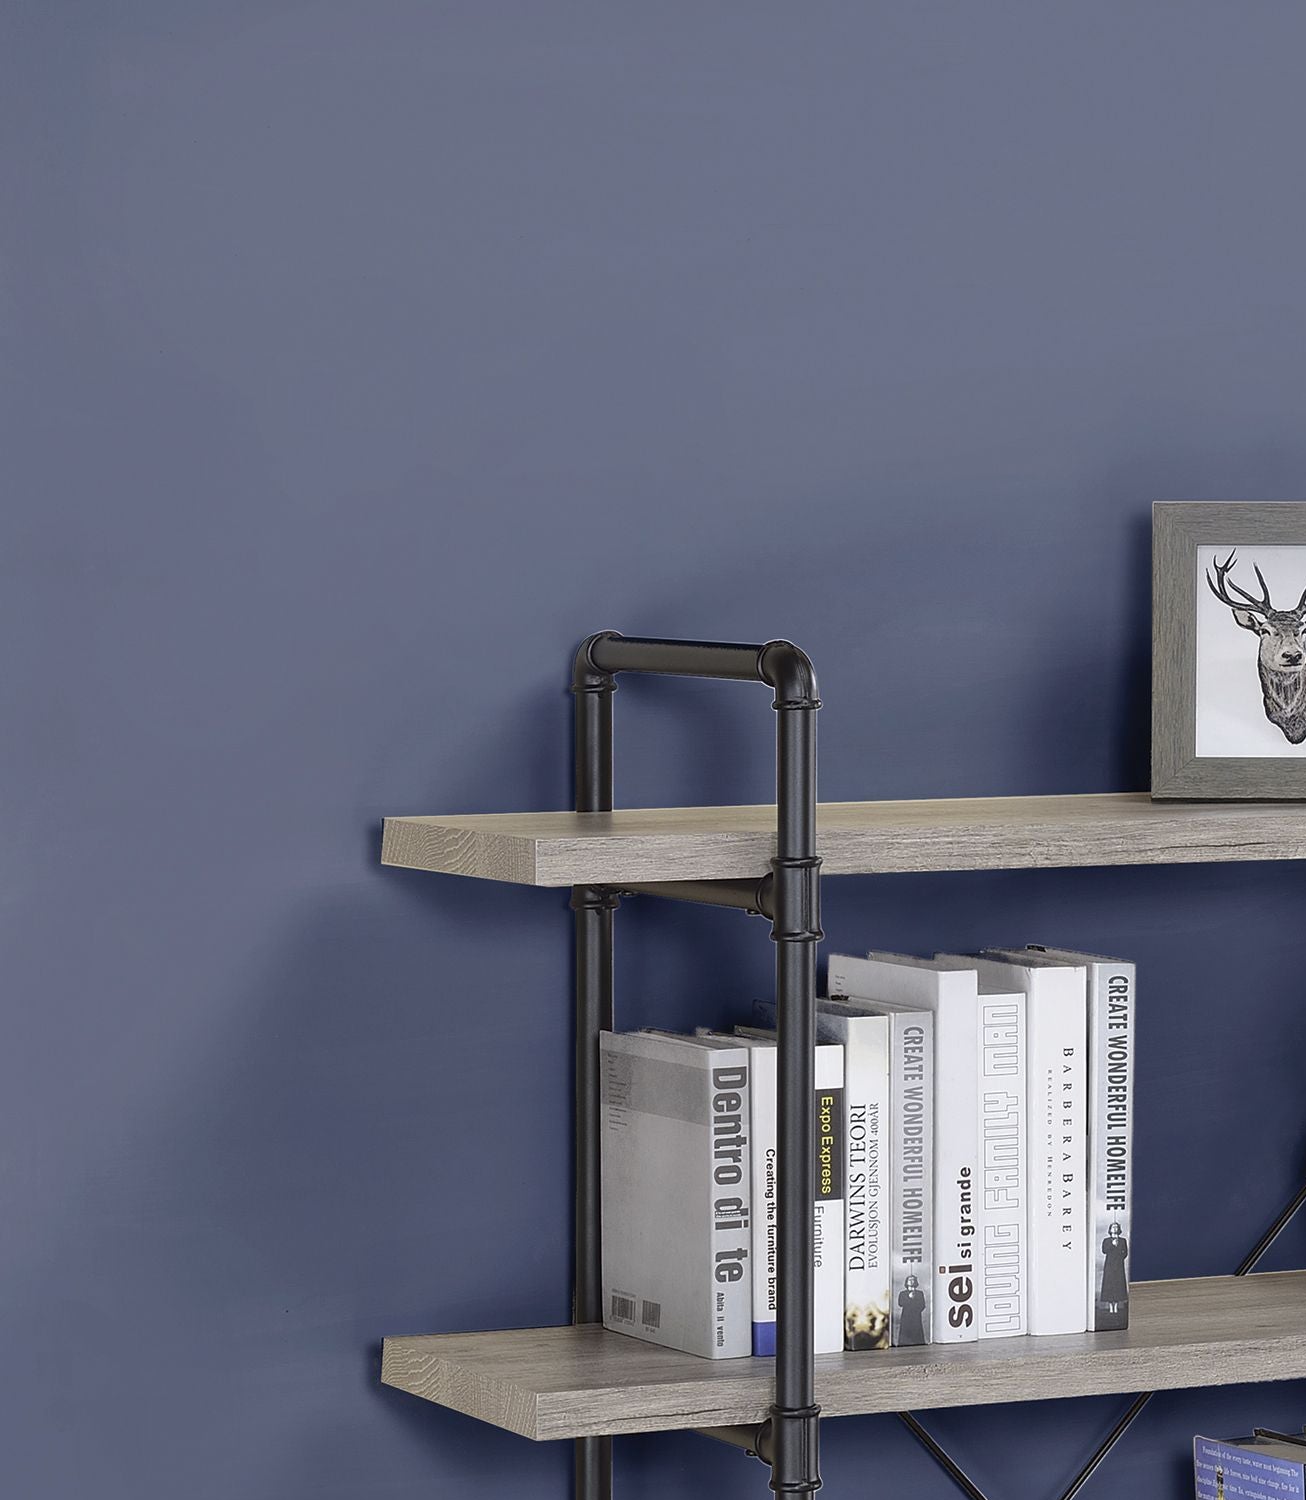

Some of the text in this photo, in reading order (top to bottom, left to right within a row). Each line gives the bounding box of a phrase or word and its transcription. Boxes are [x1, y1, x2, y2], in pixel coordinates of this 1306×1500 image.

[712, 1066, 747, 1185] Dentro
[1106, 975, 1129, 1211] CREATE WONDERFUL HOMELIFE
[819, 1096, 833, 1194] Expo Express
[849, 1104, 867, 1271] DARWINS TEORI
[868, 1138, 881, 1197] GJENNOM
[902, 1026, 925, 1263] CREATE WONDERFUL HOMELIFE
[983, 1004, 1020, 1332] LOVING FAMILY MAN
[714, 1197, 749, 1231] di
[765, 1148, 777, 1311] Creating the furniture brand
[814, 1206, 825, 1268] Furniture
[868, 1200, 881, 1269] EVOLUSJON
[938, 1166, 975, 1328] sei si grande
[714, 1247, 748, 1283] te
[716, 1292, 725, 1312] Abita
[716, 1326, 725, 1347] vento
